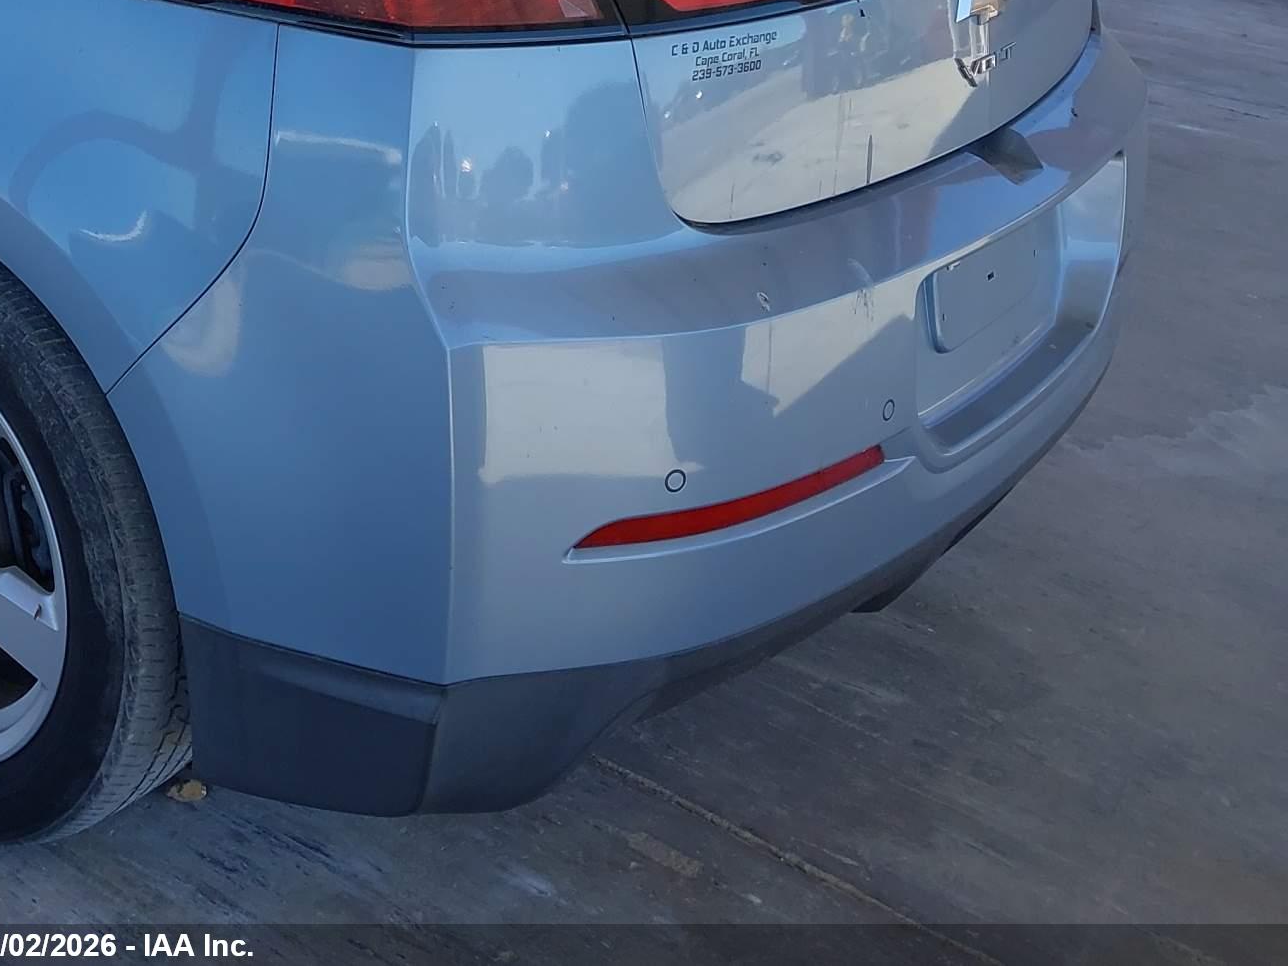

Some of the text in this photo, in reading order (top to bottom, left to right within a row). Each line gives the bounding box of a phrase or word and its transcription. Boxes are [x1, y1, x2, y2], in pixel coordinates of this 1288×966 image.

[671, 44, 679, 57] C
[681, 42, 689, 55] &
[702, 38, 727, 52] Auto
[728, 31, 778, 48] Exchange
[695, 46, 760, 67] Cape Coral, FL
[691, 59, 762, 82] 239-573-3600
